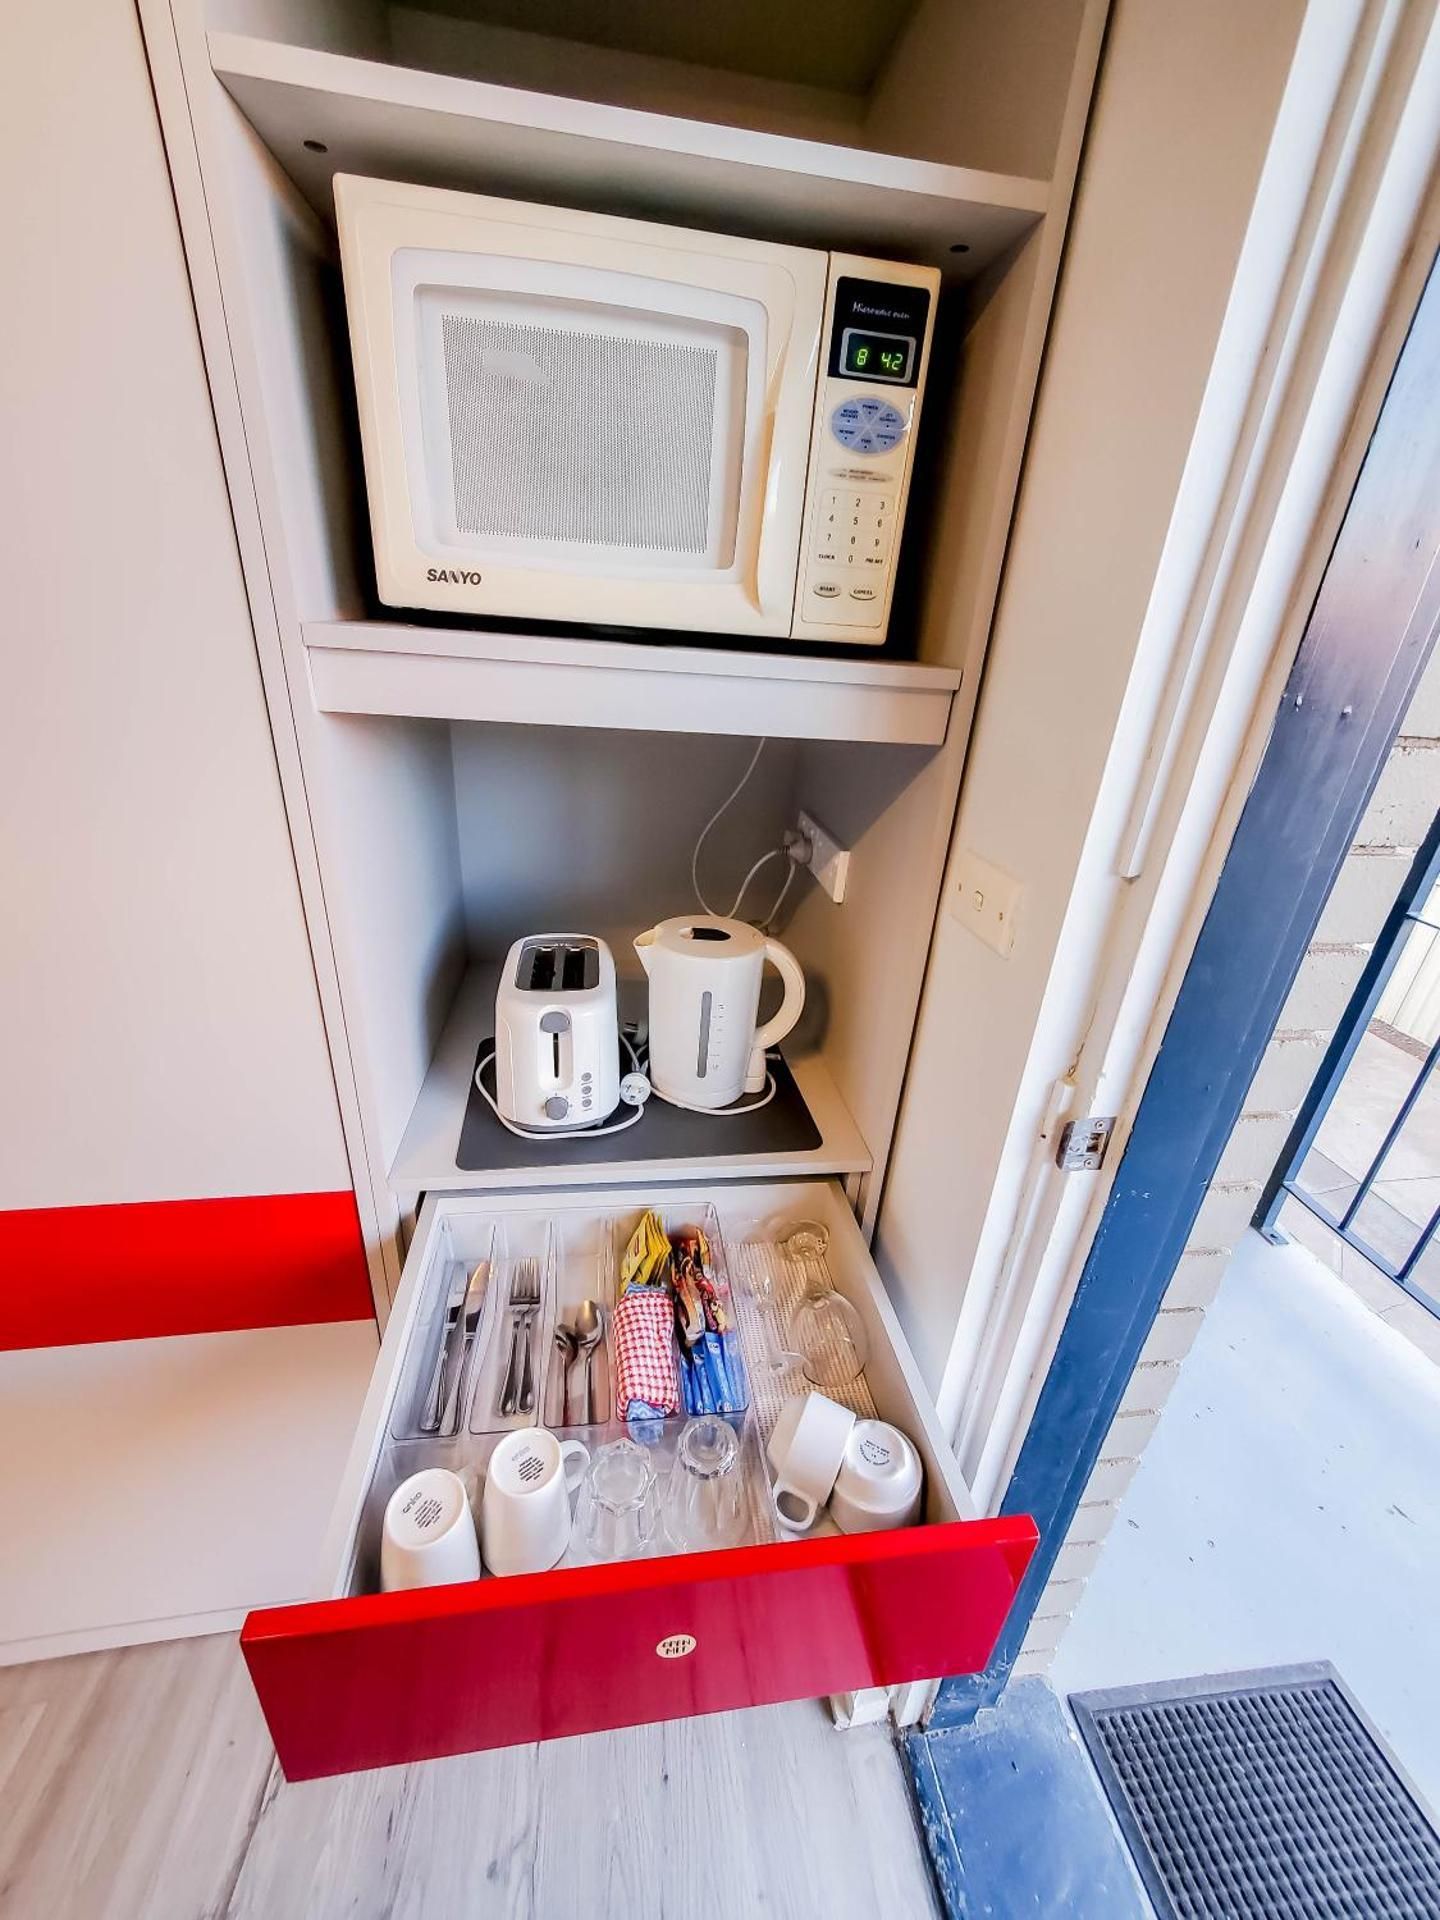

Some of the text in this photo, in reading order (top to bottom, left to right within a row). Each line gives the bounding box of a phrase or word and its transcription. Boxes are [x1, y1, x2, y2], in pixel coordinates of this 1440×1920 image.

[856, 348, 904, 371] 8 42
[855, 498, 861, 508] 2
[880, 501, 885, 510] 3
[828, 515, 883, 528] 4 5 6
[850, 536, 856, 545] 8
[874, 538, 880, 547] 9
[848, 555, 853, 564] 0
[426, 568, 482, 586] SANYO
[662, 1638, 691, 1648] OPEN
